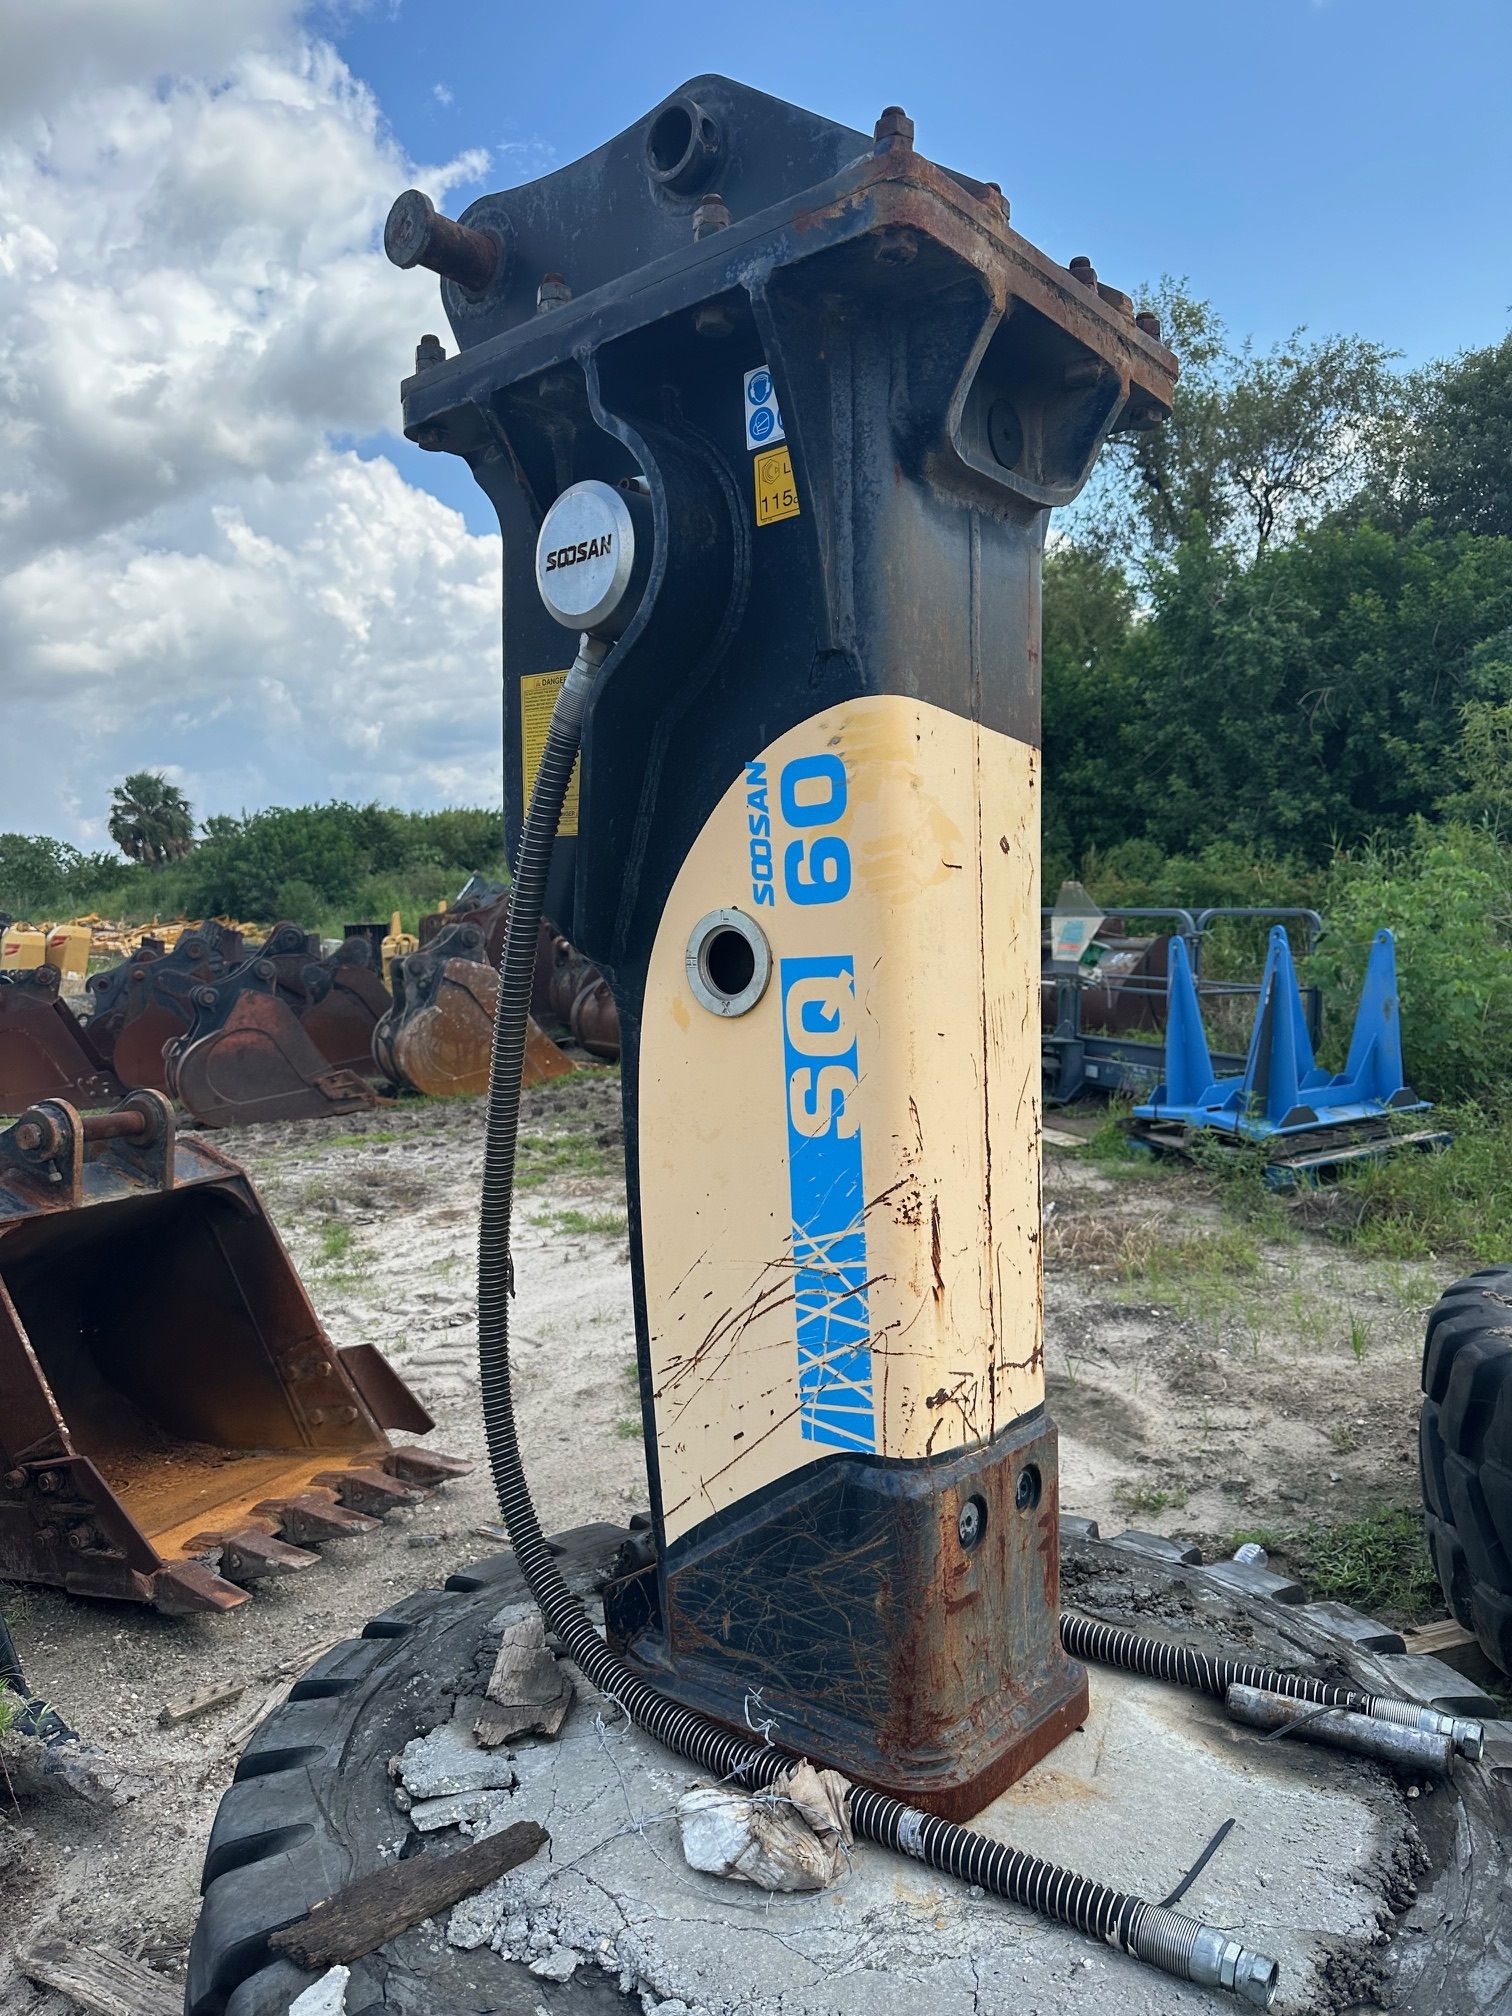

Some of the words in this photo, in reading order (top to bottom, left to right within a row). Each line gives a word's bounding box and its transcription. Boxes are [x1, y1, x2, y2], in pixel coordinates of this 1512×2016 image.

[546, 534, 612, 572] SOOSAN
[745, 762, 774, 906] SOOSAN
[781, 754, 850, 905] 60
[786, 969, 860, 1139] SQ
